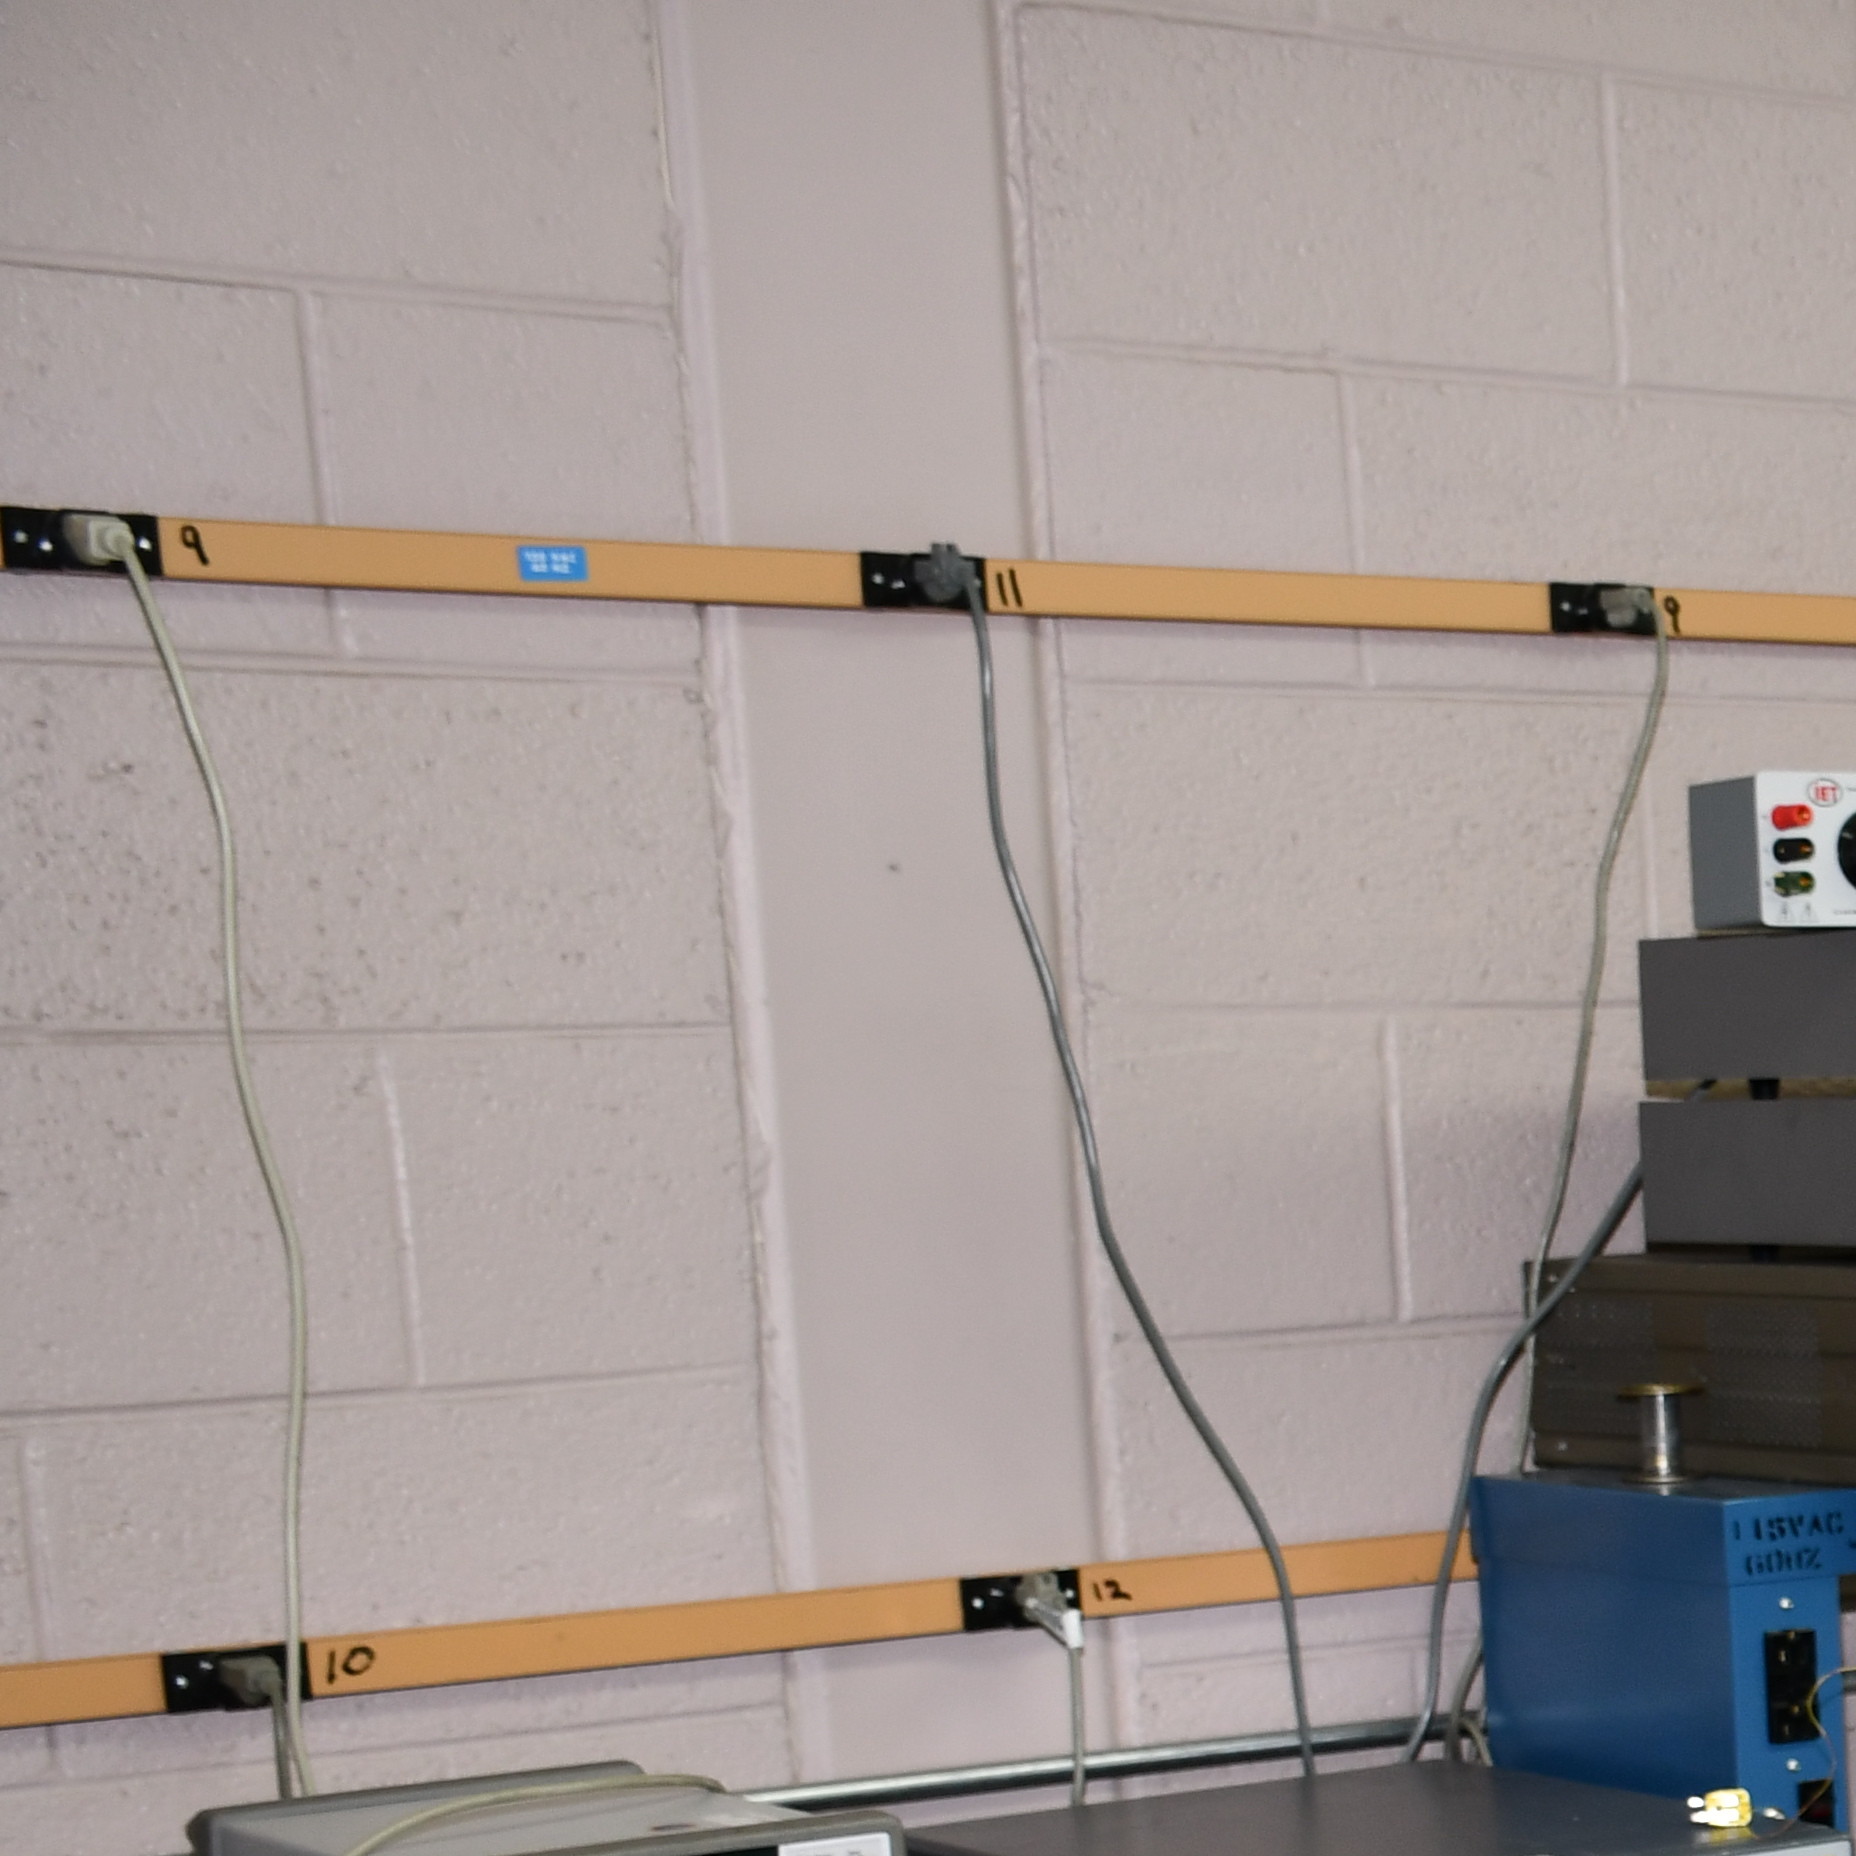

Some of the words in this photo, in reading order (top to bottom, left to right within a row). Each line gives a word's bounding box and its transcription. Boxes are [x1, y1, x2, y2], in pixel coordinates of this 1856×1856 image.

[180, 525, 210, 566] 9
[997, 569, 1023, 607] 11
[1093, 1578, 1133, 1602] 12
[325, 1645, 375, 1685] 10
